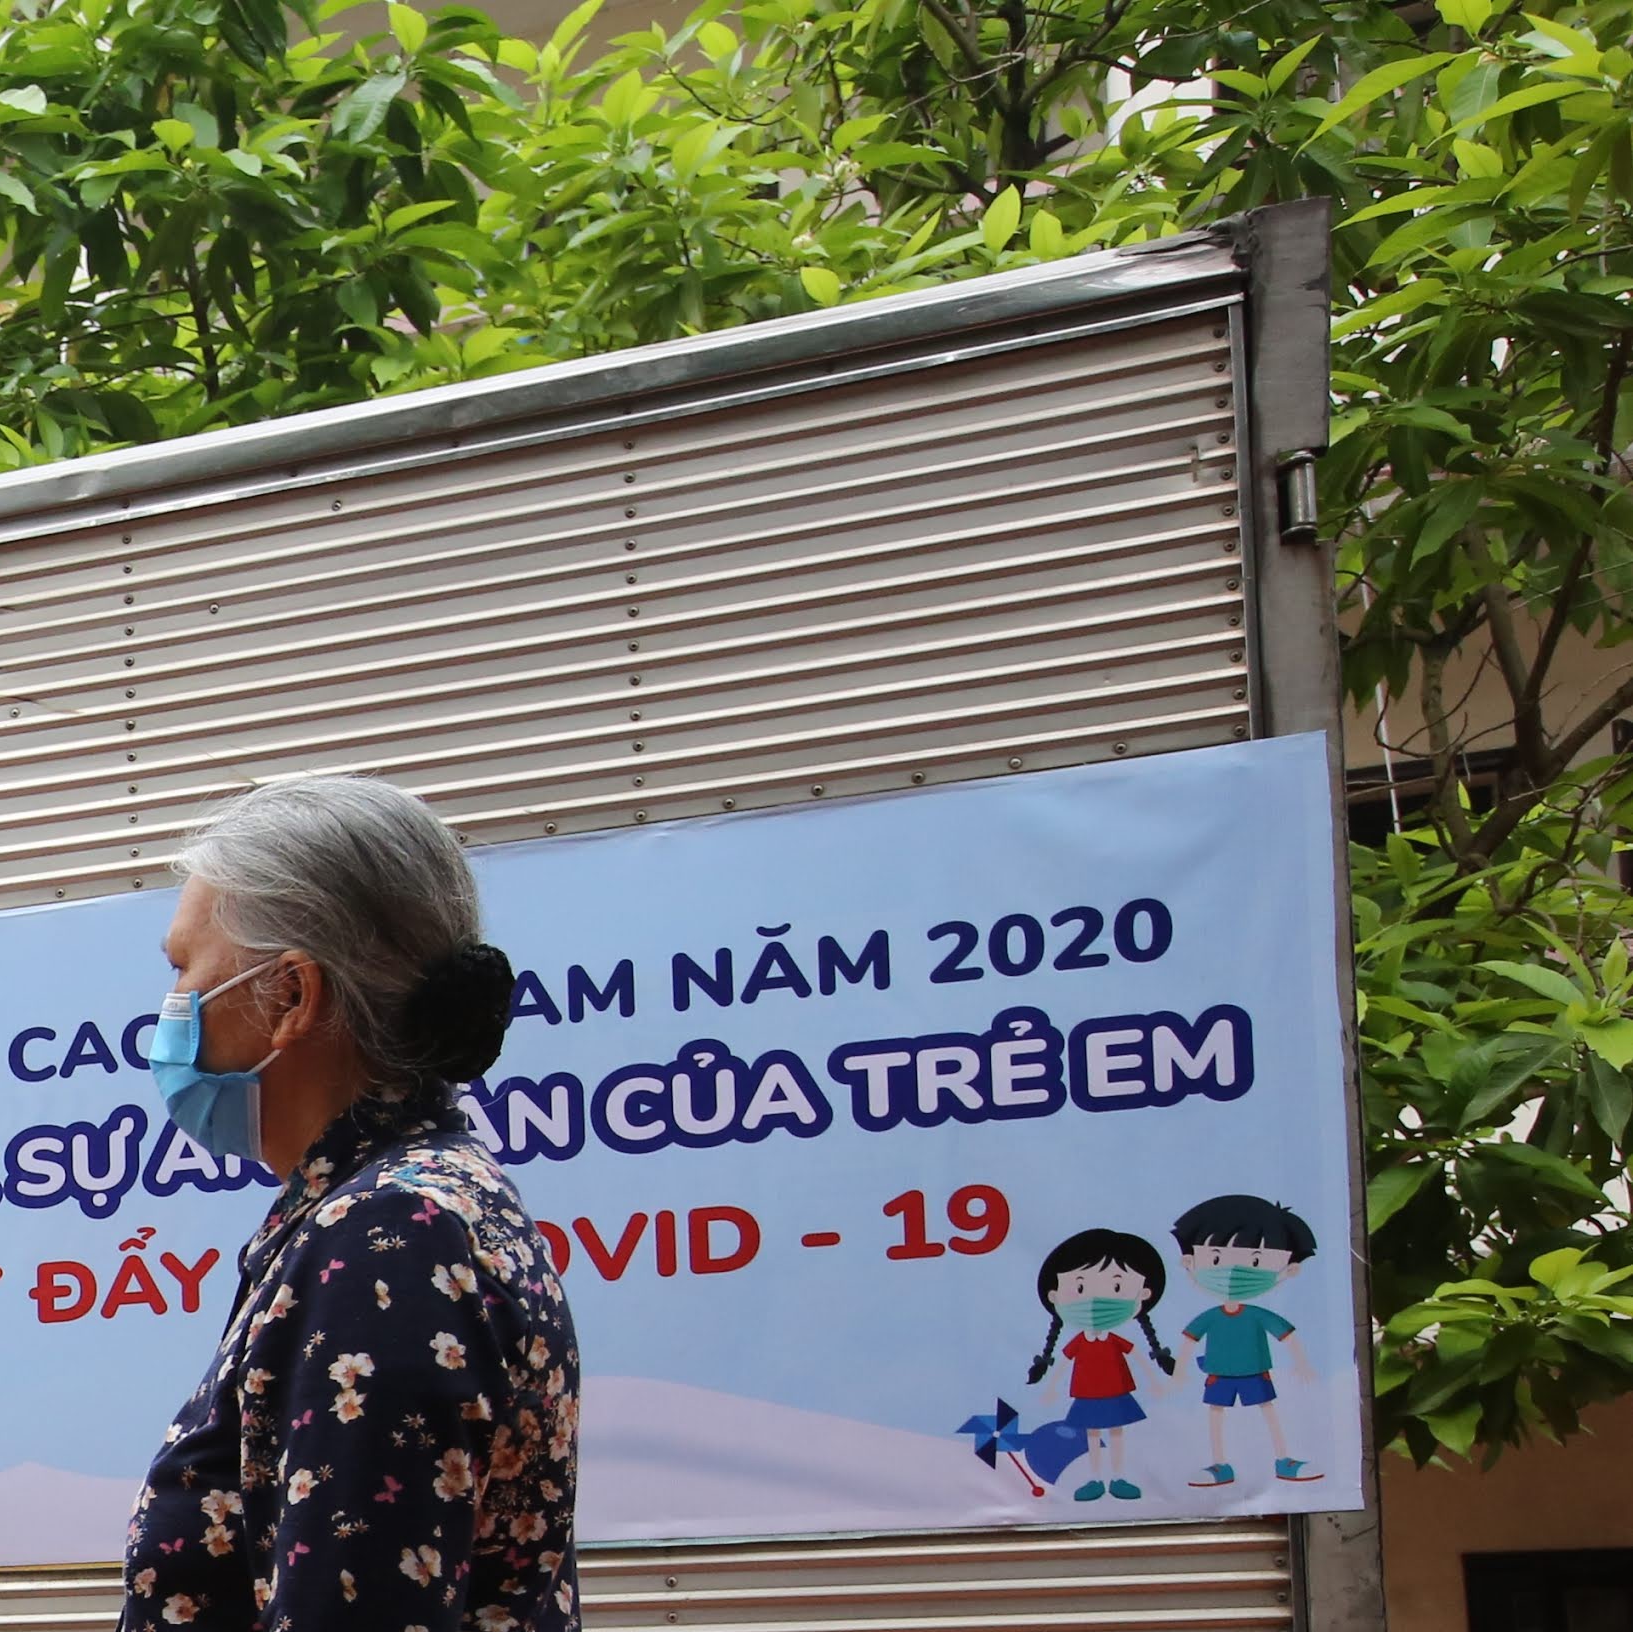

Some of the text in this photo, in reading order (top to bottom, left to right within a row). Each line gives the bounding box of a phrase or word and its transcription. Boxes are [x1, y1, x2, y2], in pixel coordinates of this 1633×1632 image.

[502, 957, 637, 1028] AM
[670, 922, 892, 1008] NĂM
[926, 896, 1174, 985] 2020
[13, 1110, 141, 1213] SỰ
[456, 1080, 573, 1157] ÀN
[600, 1049, 820, 1147] CỦA
[840, 1022, 1051, 1115] TRẺ
[1081, 1016, 1240, 1100] EM
[28, 1225, 221, 1323] ĐẨY
[533, 1205, 761, 1282] VID
[799, 1230, 841, 1248] -
[882, 1184, 1011, 1260] 19
